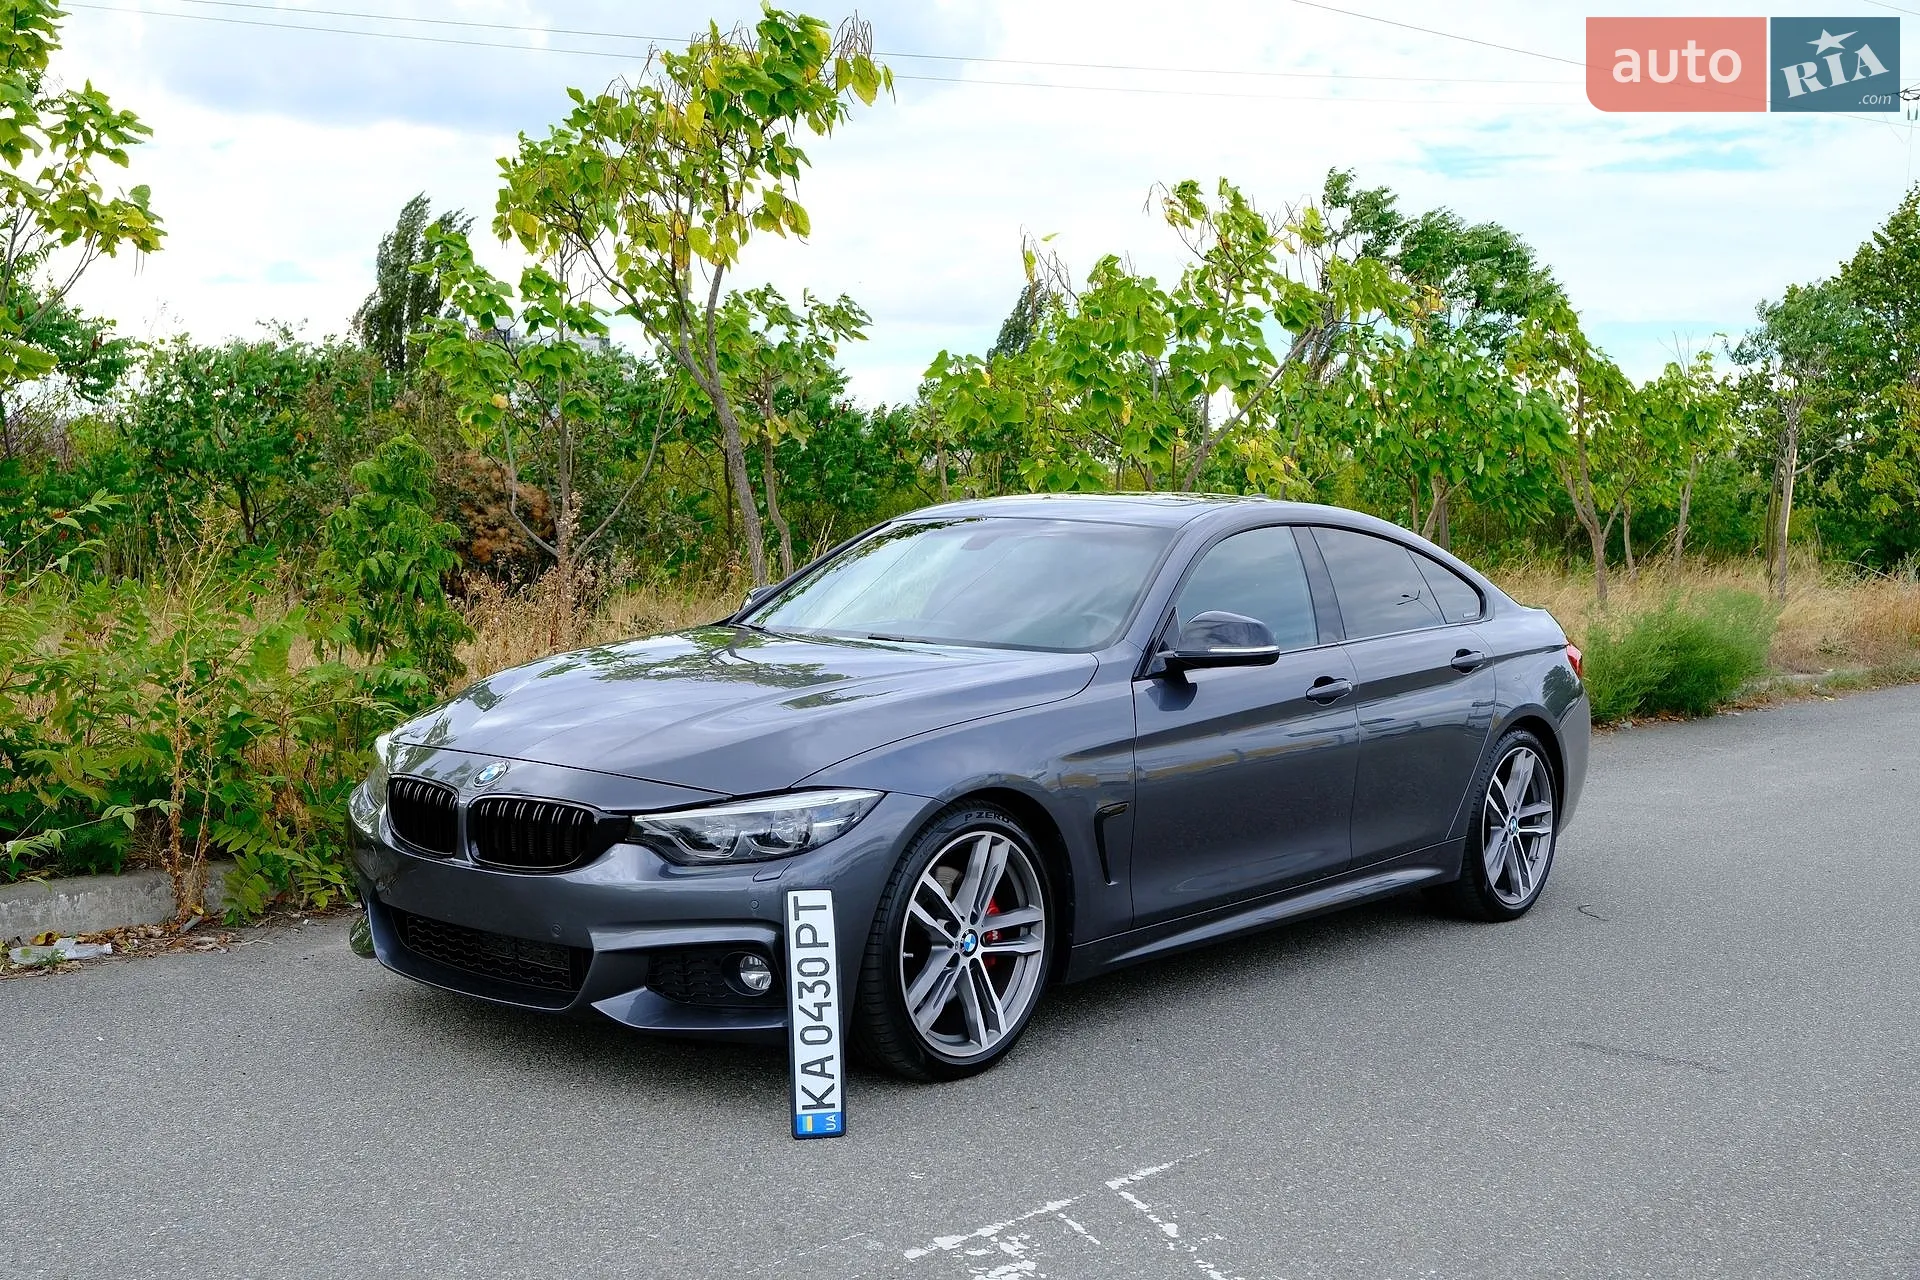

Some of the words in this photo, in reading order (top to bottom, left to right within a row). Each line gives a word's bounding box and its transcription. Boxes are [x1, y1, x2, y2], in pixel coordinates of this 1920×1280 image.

[964, 813, 973, 821] P
[976, 811, 1010, 824] ZERO
[825, 1114, 837, 1131] UA
